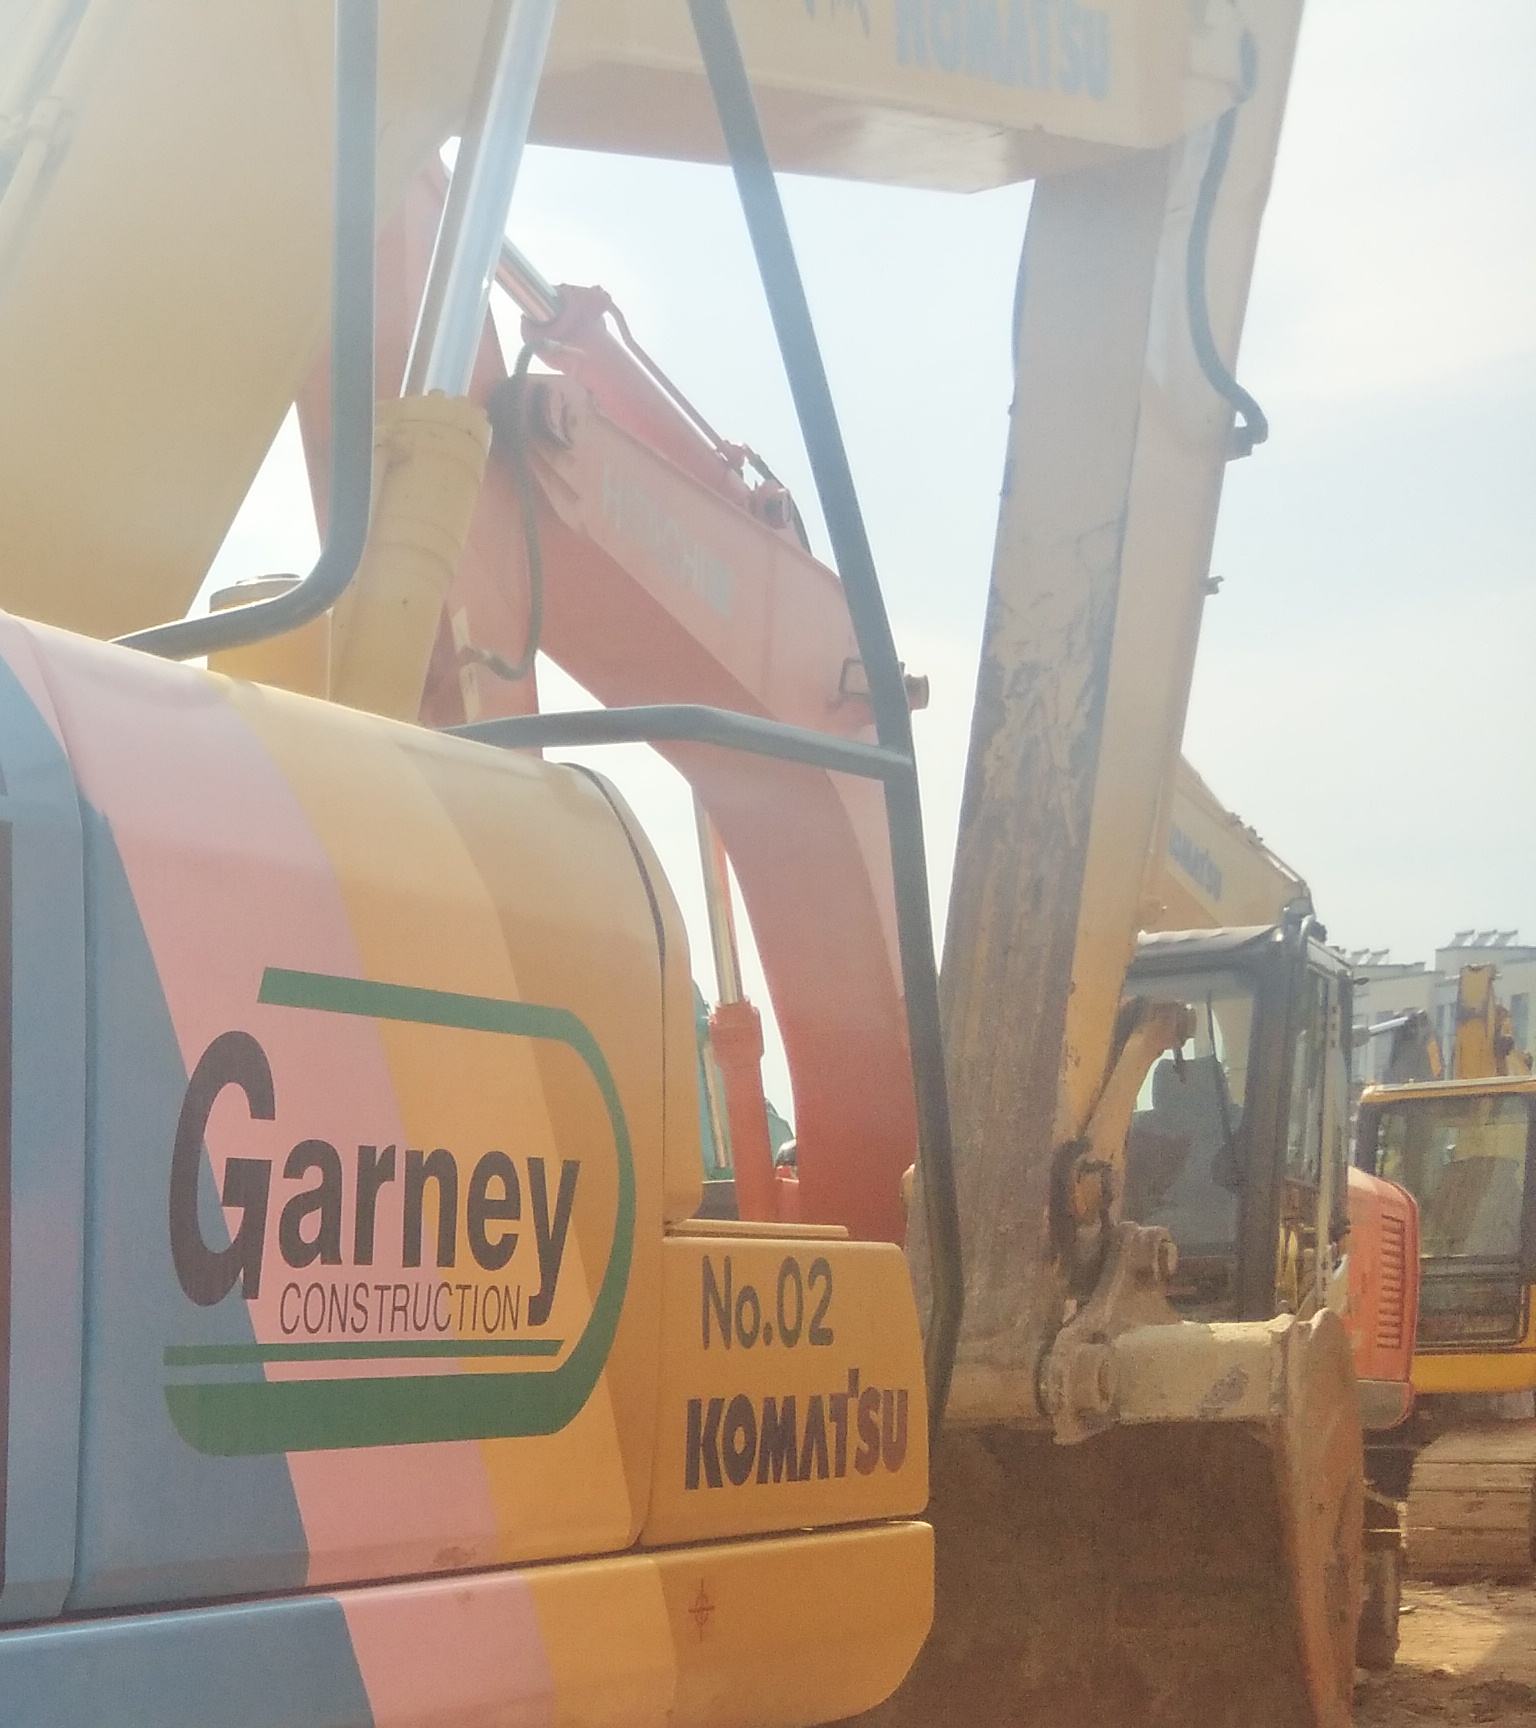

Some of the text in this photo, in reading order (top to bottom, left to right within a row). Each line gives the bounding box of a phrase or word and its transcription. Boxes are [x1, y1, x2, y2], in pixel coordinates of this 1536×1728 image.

[169, 1030, 580, 1326] Garney
[280, 1282, 520, 1334] CONSTRUCTION
[701, 1256, 834, 1350] No.02
[685, 1368, 909, 1490] KOMATSU
